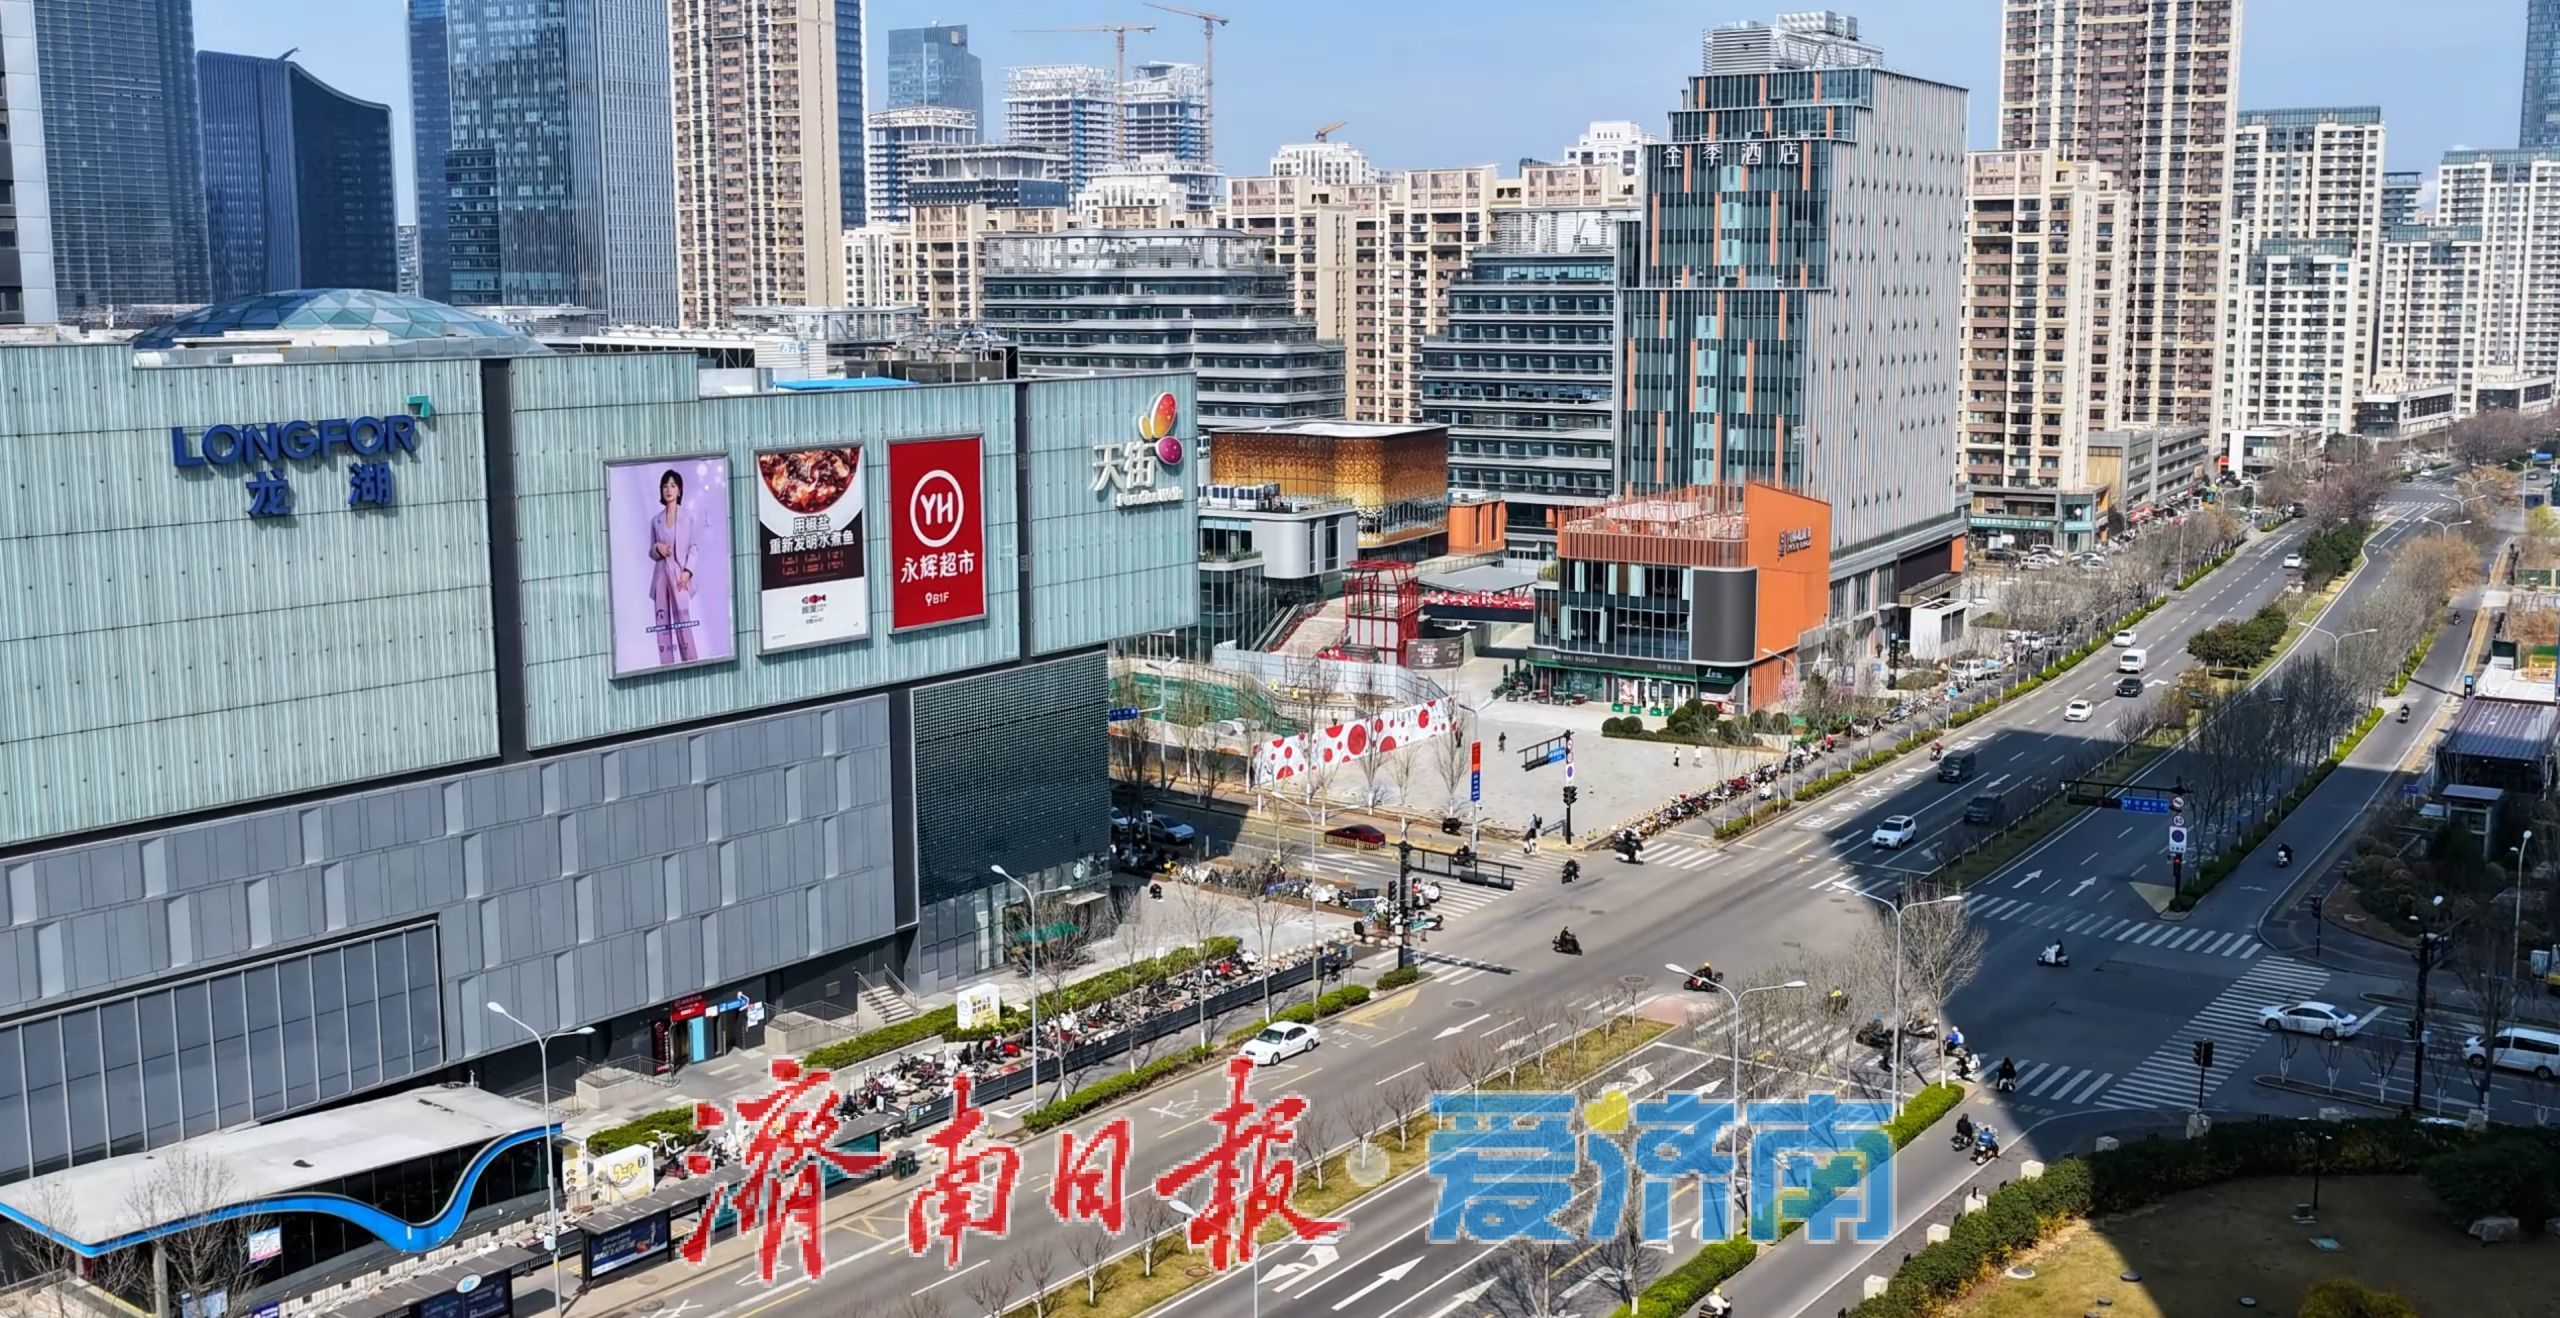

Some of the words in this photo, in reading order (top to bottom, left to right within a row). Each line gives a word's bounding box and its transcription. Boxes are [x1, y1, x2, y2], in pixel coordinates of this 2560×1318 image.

[171, 414, 417, 468] LONGFOR
[1092, 441, 1157, 492] 天街
[920, 491, 953, 526] YH
[769, 530, 855, 555] 重新发明水煮鱼
[900, 549, 975, 584] 永辉超市
[932, 591, 950, 605] B1F
